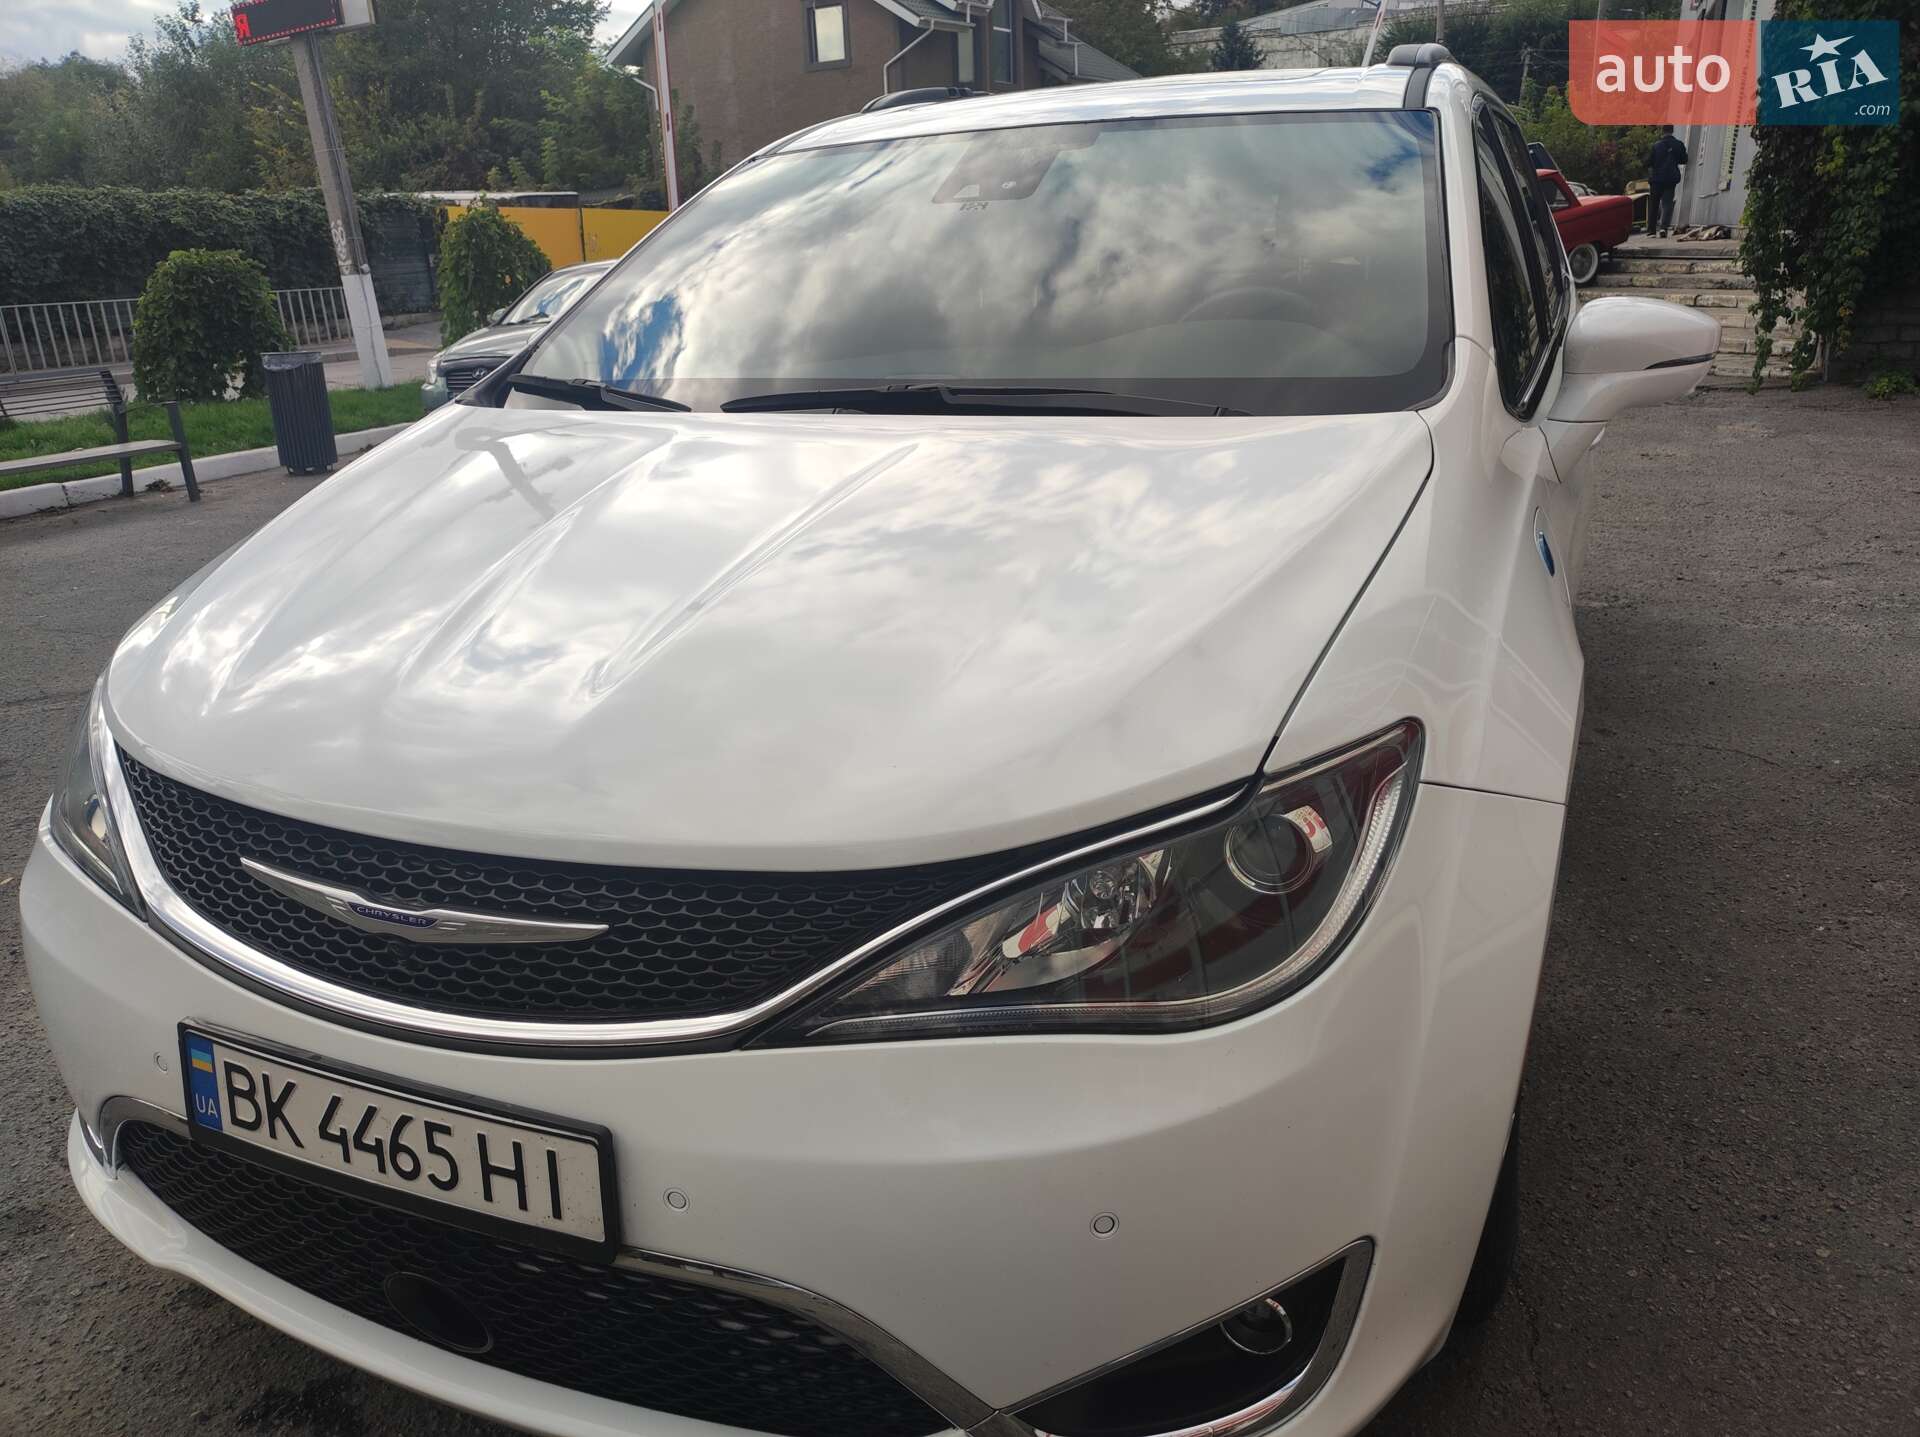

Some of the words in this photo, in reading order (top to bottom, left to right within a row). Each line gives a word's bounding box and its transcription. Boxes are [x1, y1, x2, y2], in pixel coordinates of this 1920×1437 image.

[356, 906, 427, 925] CHRYSLER
[195, 1093, 218, 1118] UA
[224, 1060, 305, 1149] BK
[318, 1095, 459, 1191] 4465
[477, 1133, 562, 1220] HI
